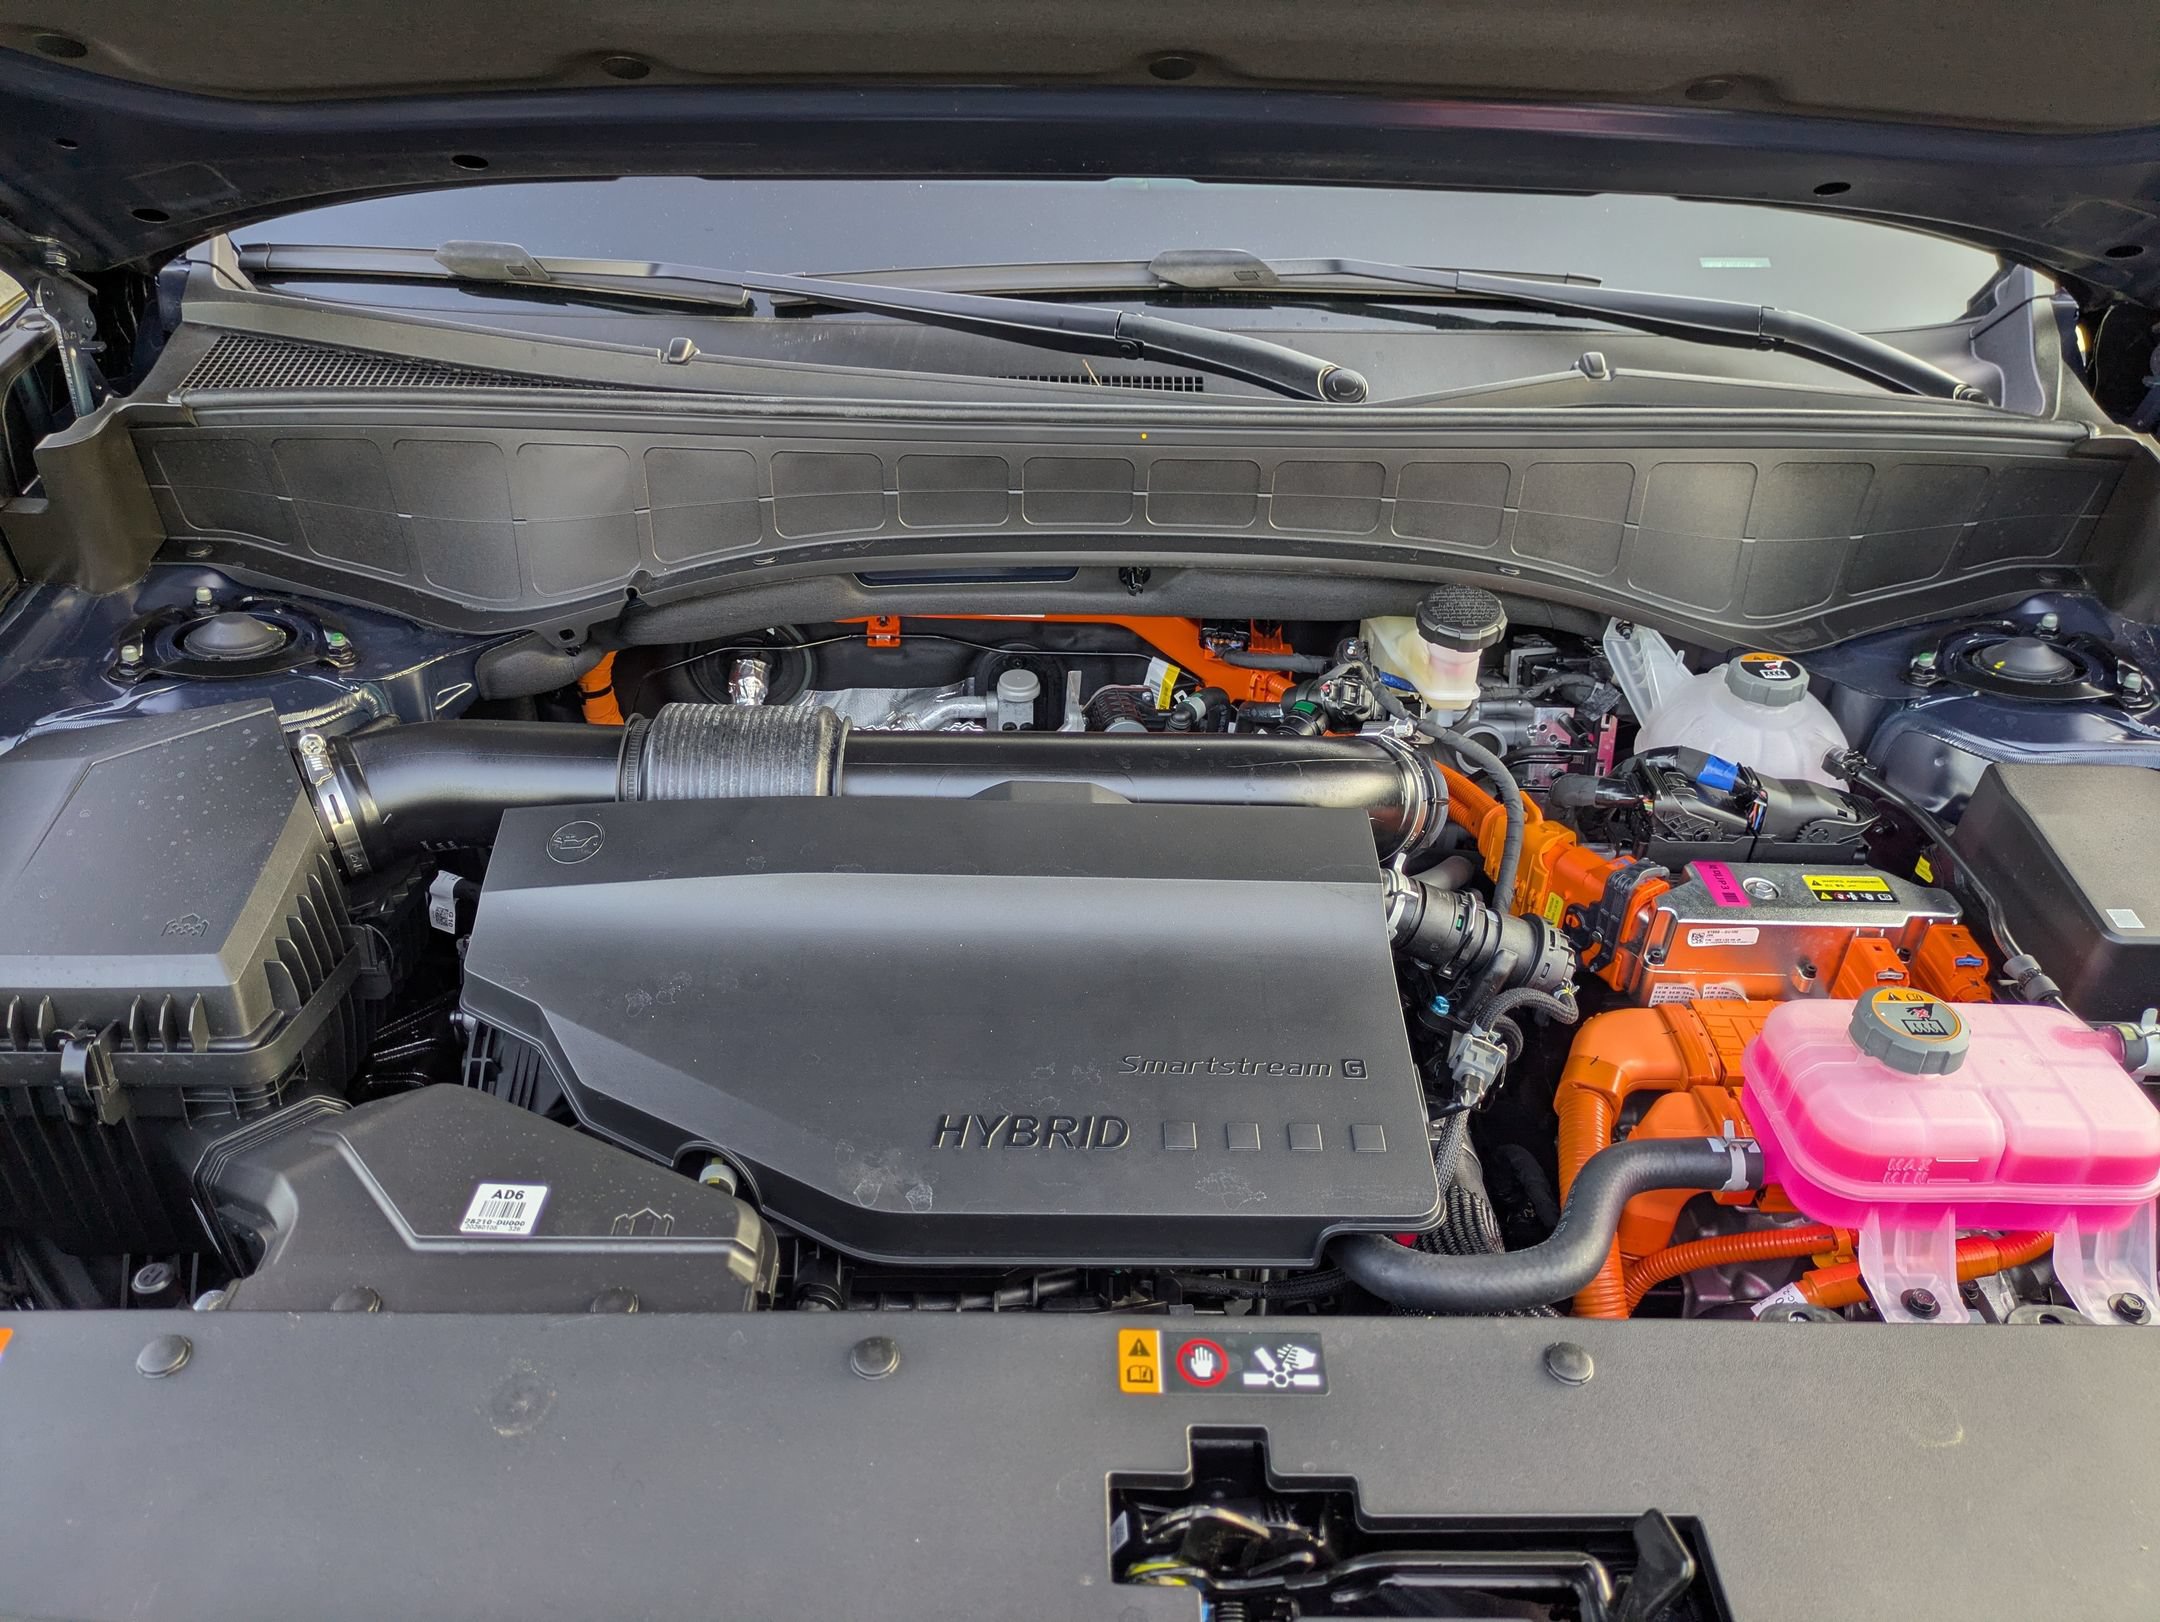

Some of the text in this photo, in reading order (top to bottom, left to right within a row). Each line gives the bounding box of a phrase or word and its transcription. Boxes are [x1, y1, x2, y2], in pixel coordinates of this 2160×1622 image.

[1118, 1055, 1367, 1079] Smartstream G
[931, 1114, 1131, 1150] HYBRID
[1886, 1157, 1933, 1171] MAX
[1882, 1171, 1929, 1185] MIN
[491, 1189, 525, 1200] AD6
